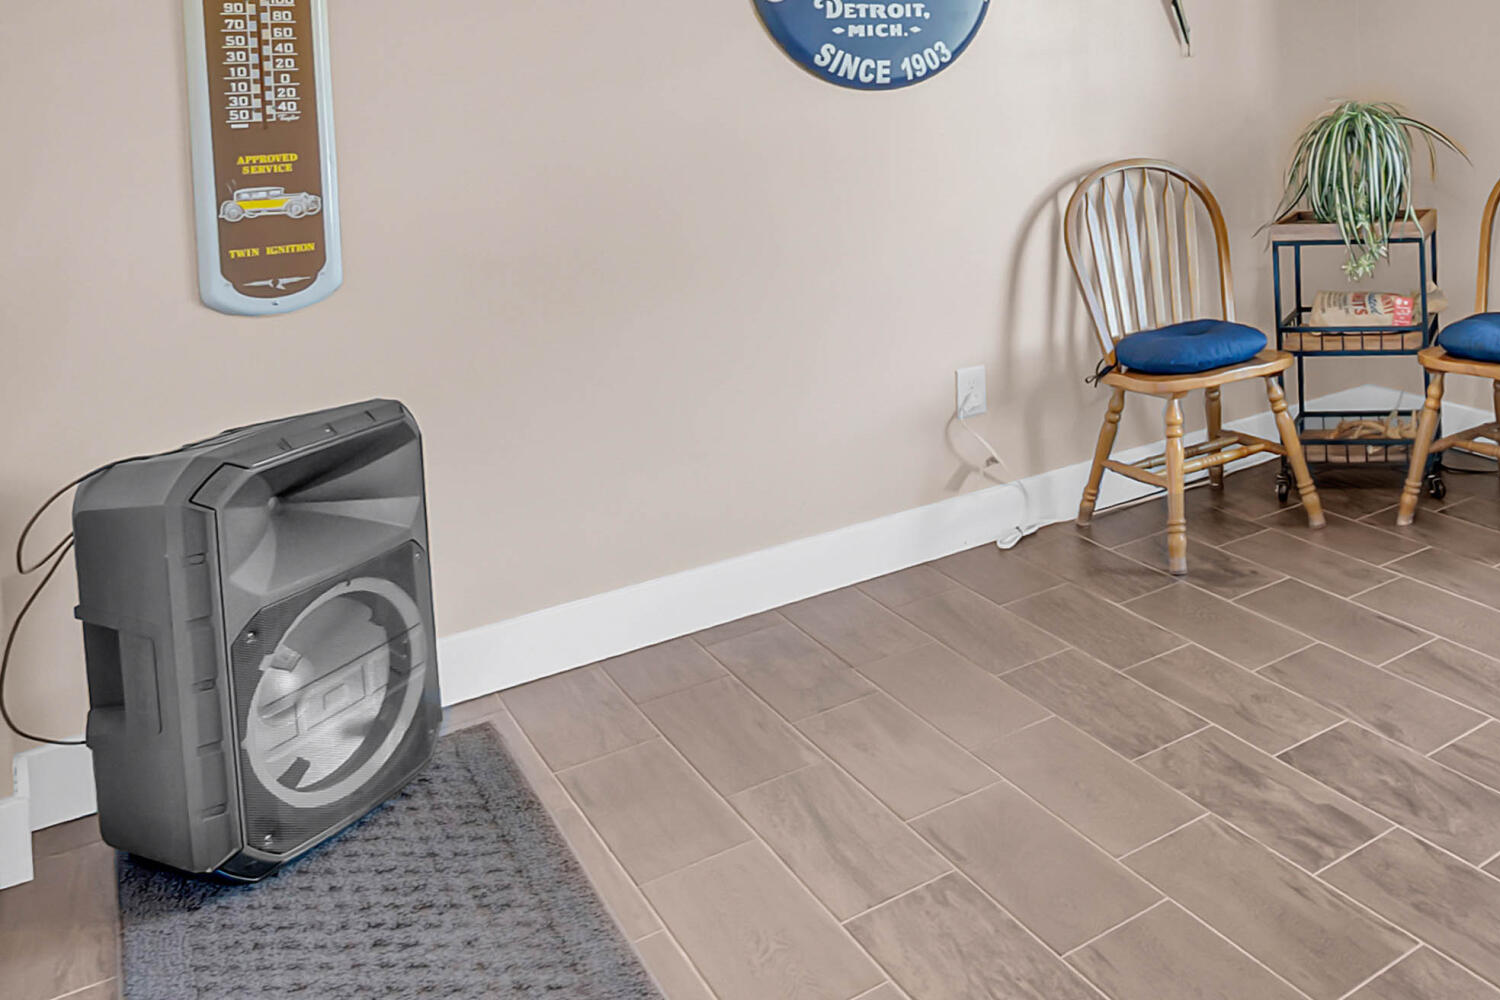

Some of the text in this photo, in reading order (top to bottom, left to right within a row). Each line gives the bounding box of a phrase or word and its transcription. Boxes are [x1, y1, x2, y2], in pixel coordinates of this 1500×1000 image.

[223, 3, 244, 13] 90
[272, 11, 292, 21] 80
[224, 19, 245, 29] 70
[273, 27, 293, 38] 60
[848, 23, 909, 37] MICH.
[225, 35, 246, 46] 50
[274, 42, 294, 53] 40
[226, 51, 247, 62] 30
[814, 40, 952, 84] SINCE 1903
[275, 58, 295, 69] 20
[229, 66, 248, 77] 10
[280, 73, 291, 84] 0
[230, 81, 248, 92] 10
[277, 87, 297, 98] 20
[228, 96, 249, 107] 30
[277, 101, 297, 111] 40
[229, 110, 250, 120] 50
[236, 152, 299, 166] APPROVED
[242, 163, 293, 175] SERVICE
[228, 242, 316, 259] TWIN IGNITION
